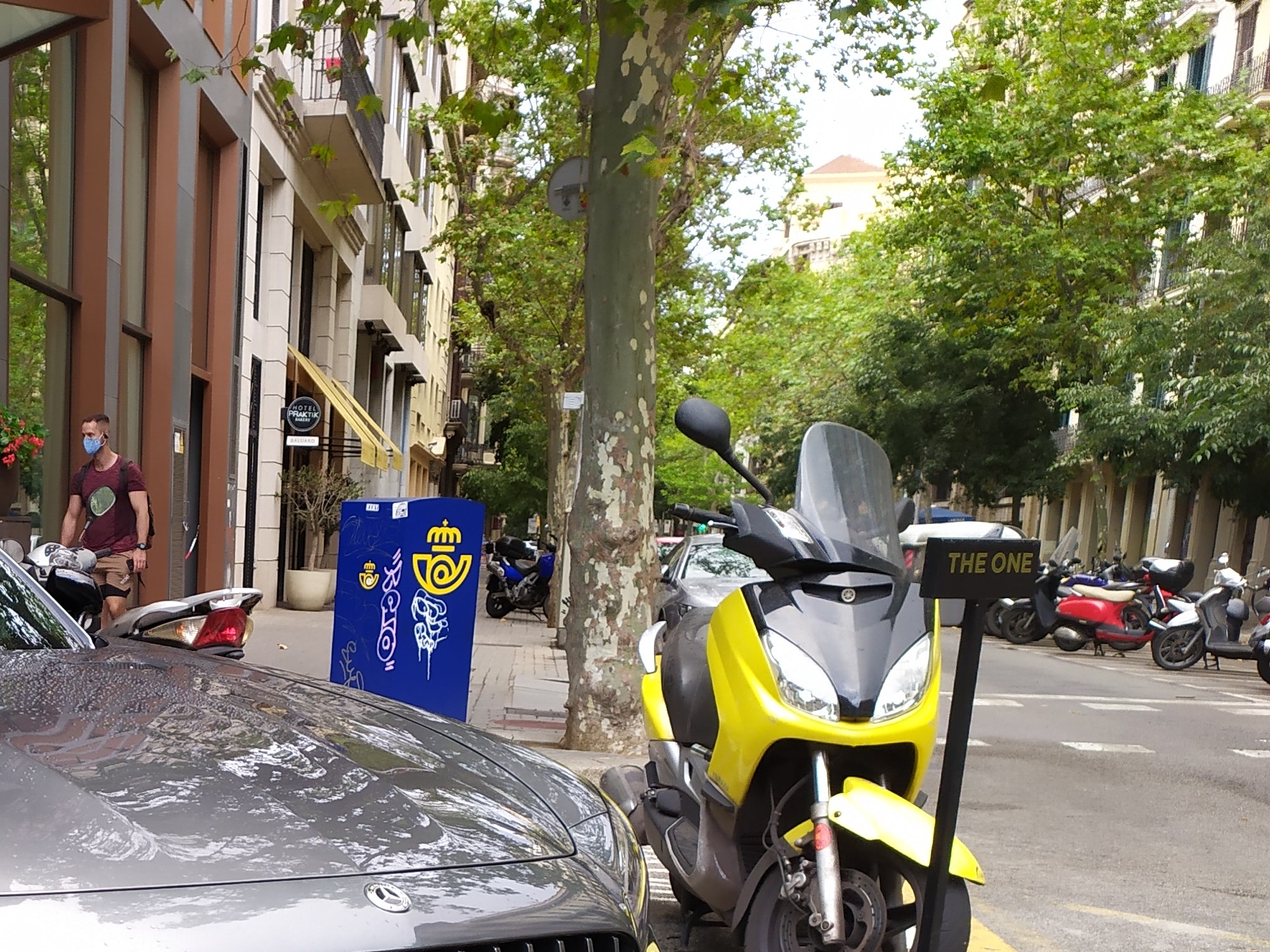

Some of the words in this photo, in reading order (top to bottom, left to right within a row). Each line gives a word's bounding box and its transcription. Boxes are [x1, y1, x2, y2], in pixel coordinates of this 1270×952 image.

[289, 410, 319, 418] PRAKTIK
[949, 552, 988, 573] THE
[991, 552, 1033, 573] ONE
